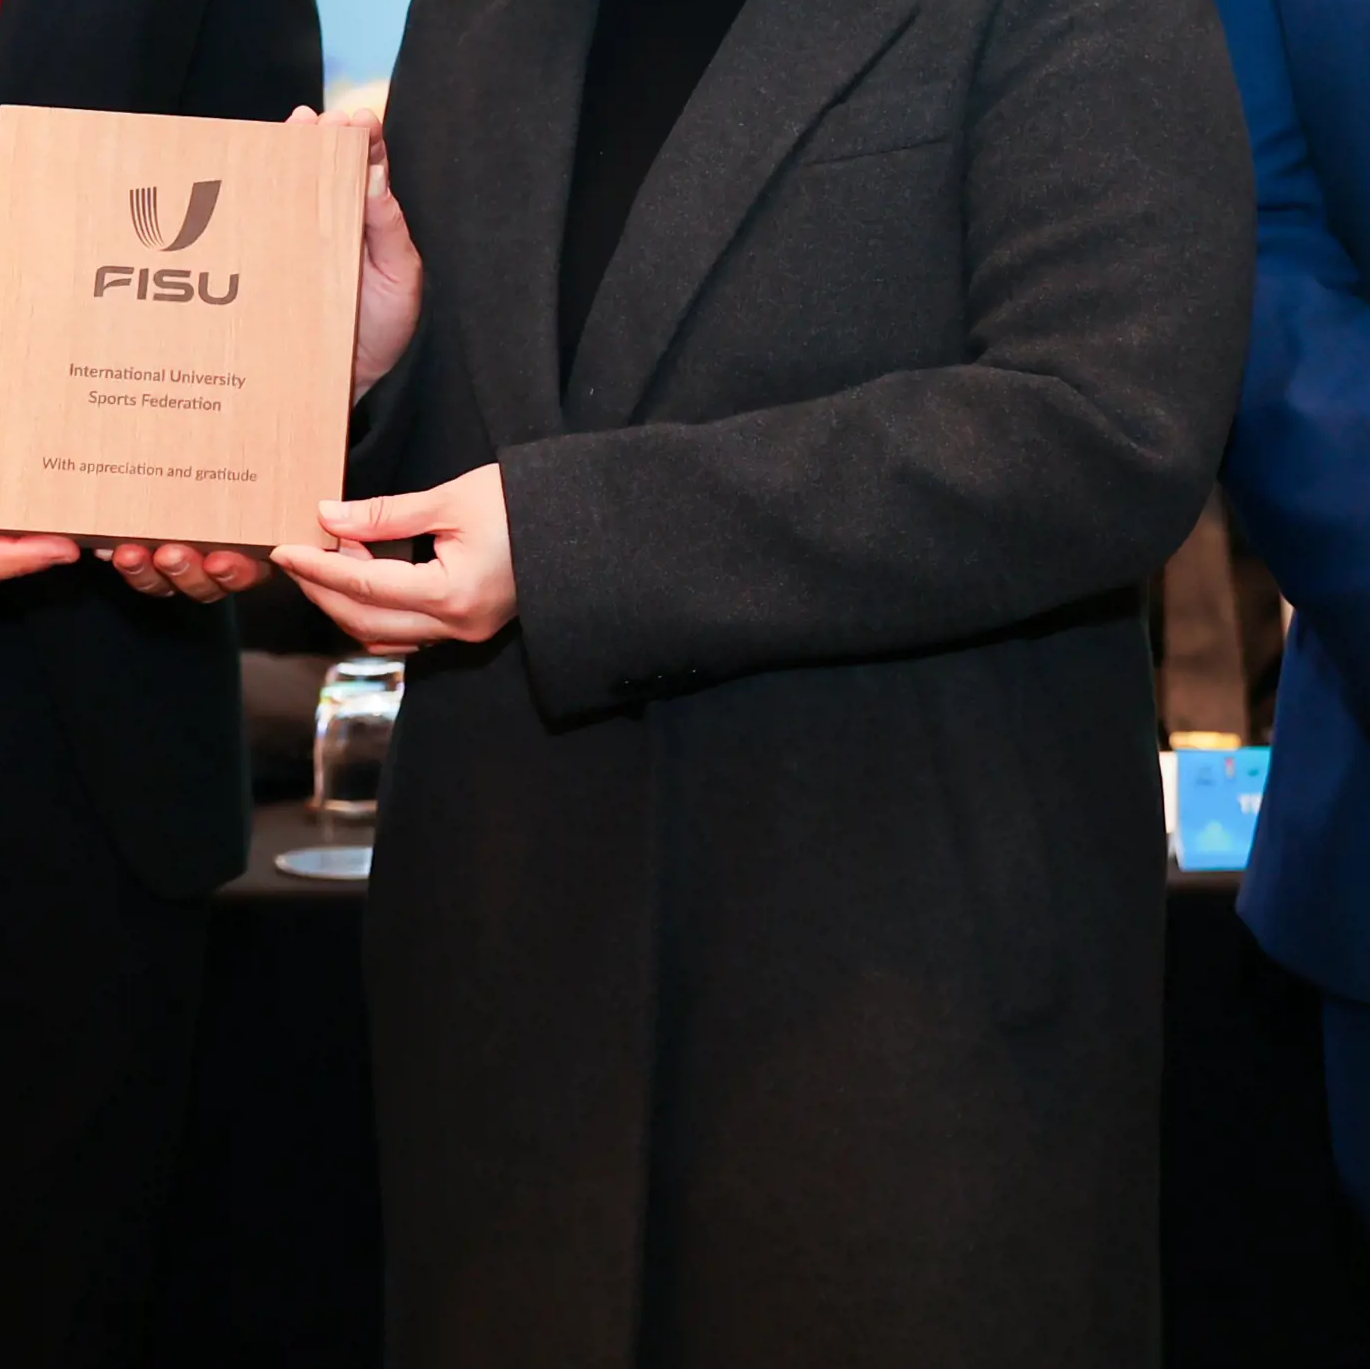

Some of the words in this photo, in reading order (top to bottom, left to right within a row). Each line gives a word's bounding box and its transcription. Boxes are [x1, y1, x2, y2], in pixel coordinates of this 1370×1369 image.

[92, 264, 241, 306] FISU
[69, 363, 166, 382] International
[170, 370, 246, 389] University
[88, 390, 137, 407] Sports
[141, 393, 222, 411] Federation
[42, 457, 75, 471] With
[79, 460, 163, 476] appreciation
[167, 466, 192, 478] and
[195, 468, 258, 482] gratitude
